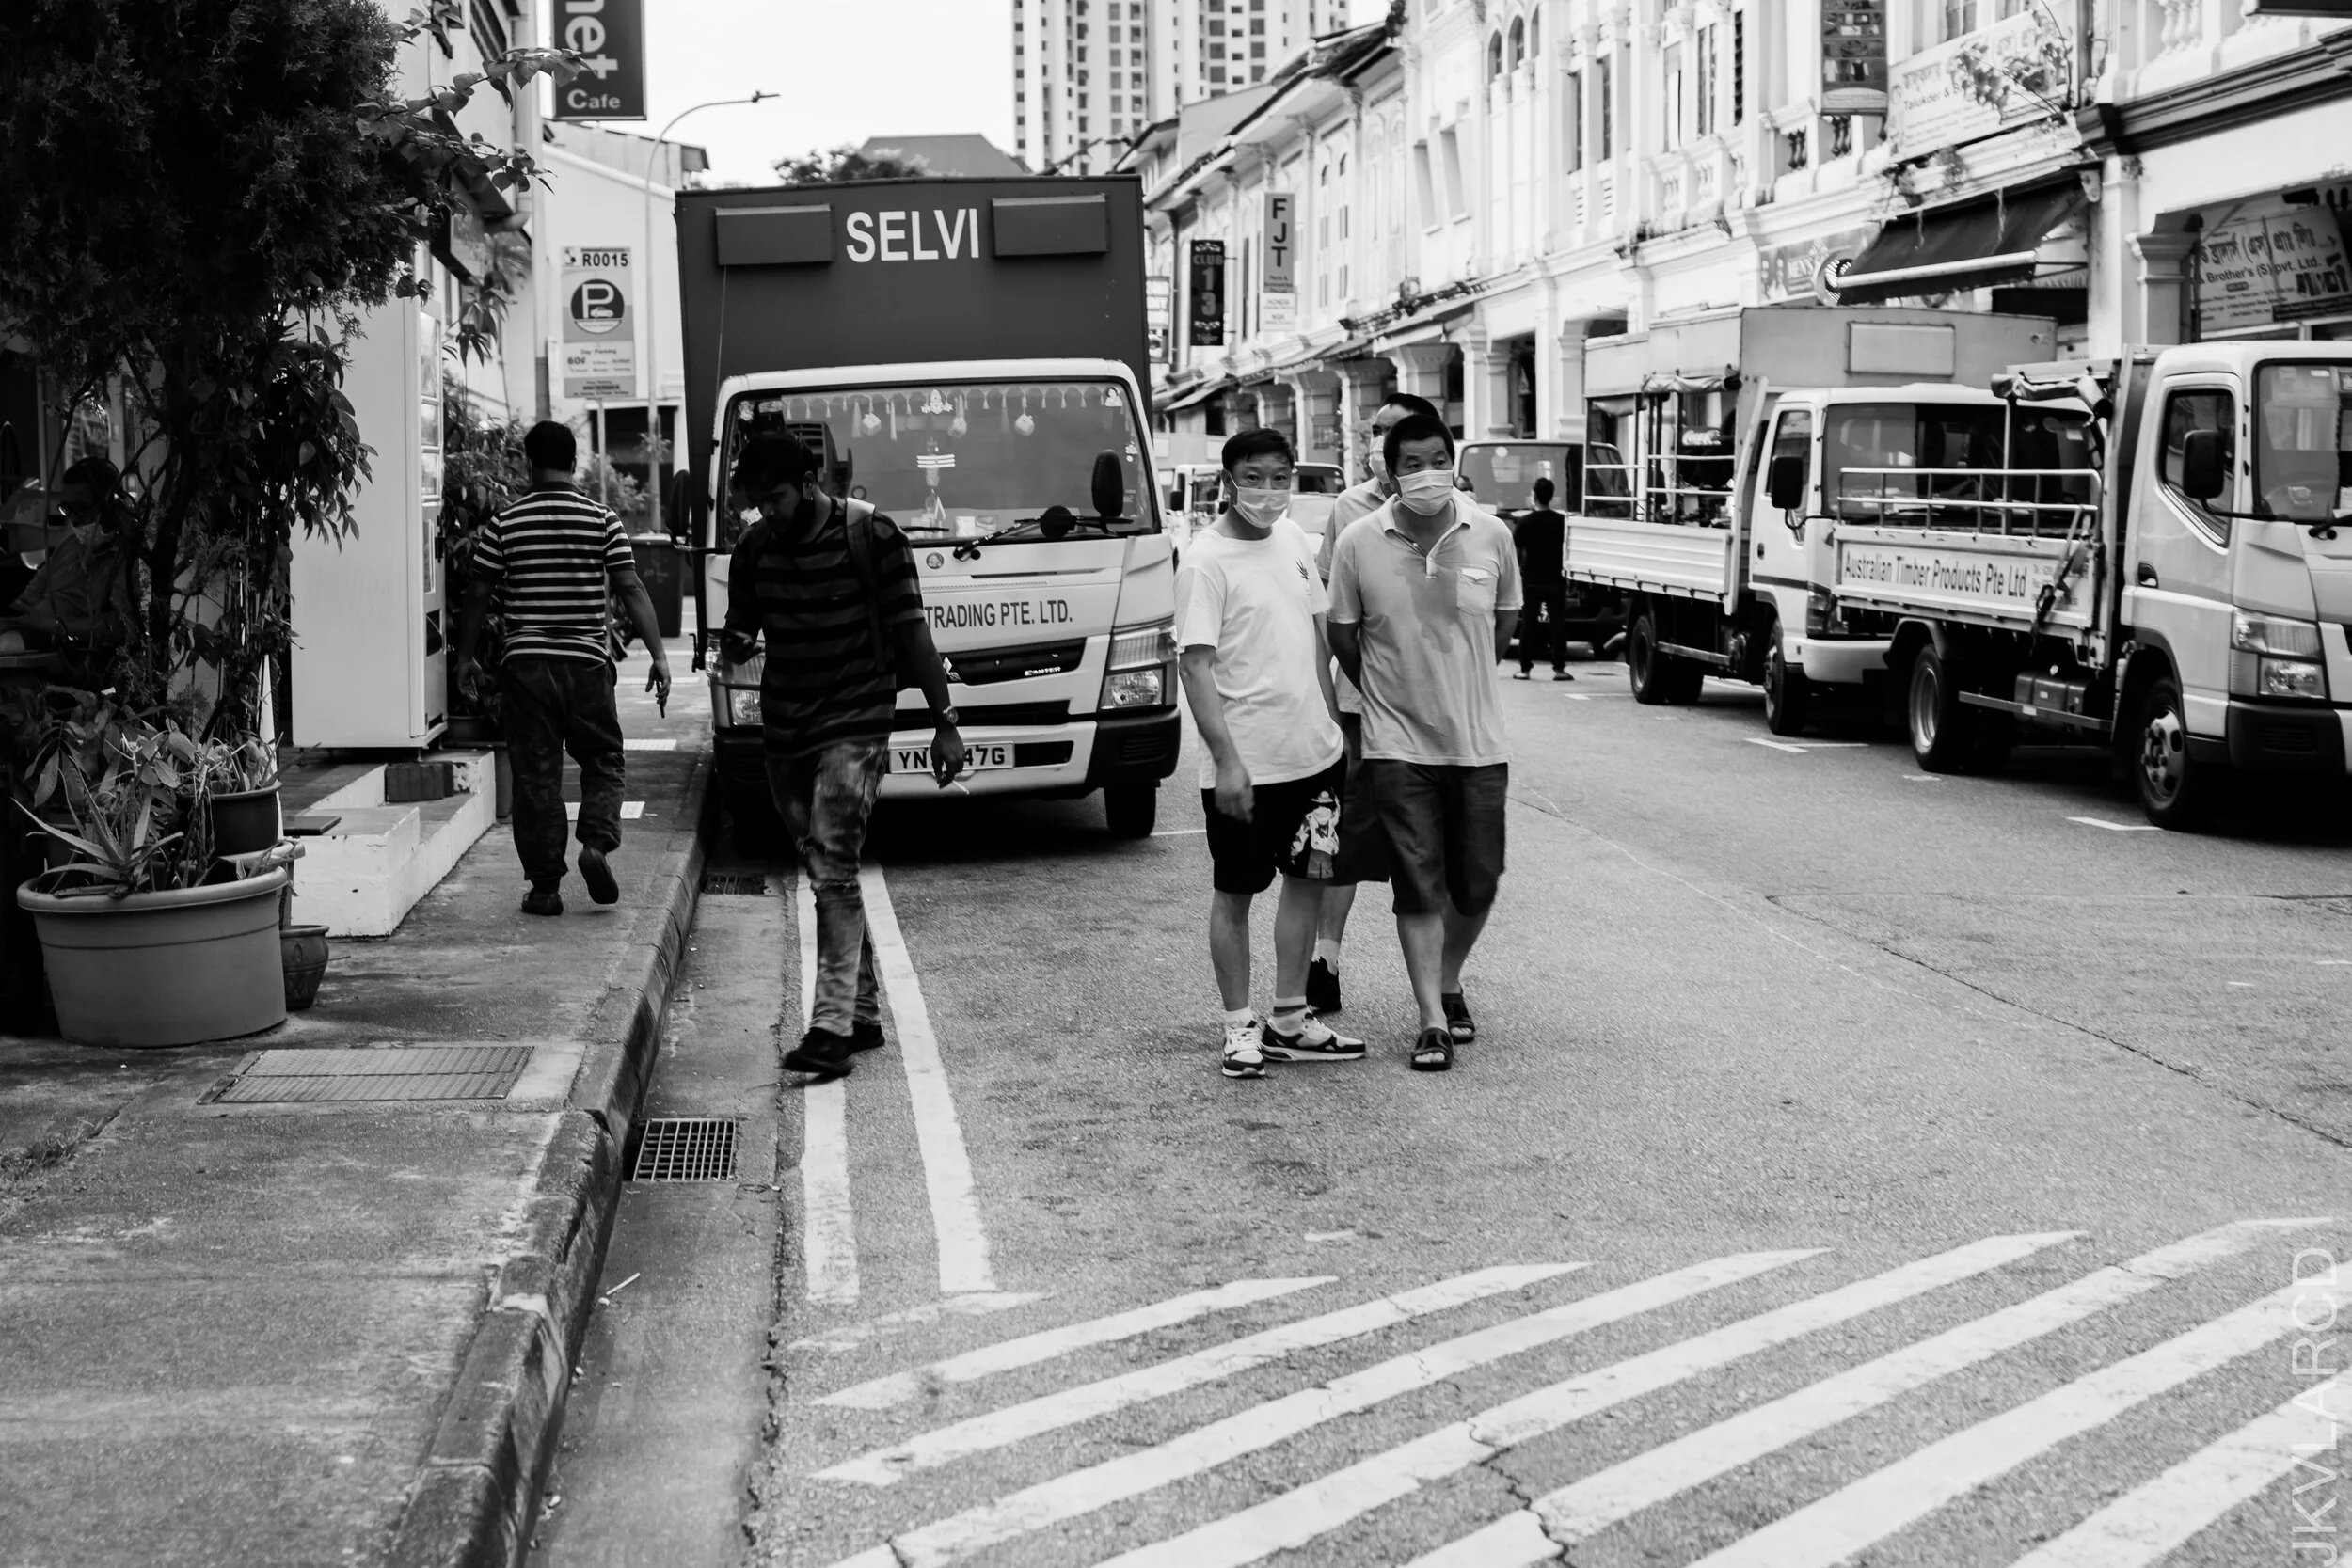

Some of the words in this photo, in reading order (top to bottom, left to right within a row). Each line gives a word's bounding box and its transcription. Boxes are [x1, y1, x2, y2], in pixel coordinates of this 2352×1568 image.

[567, 88, 621, 109] Cafe
[846, 208, 979, 262] SELVI
[1271, 198, 1288, 268] FJT
[582, 253, 628, 267] R0015
[1193, 254, 1223, 265] CLUB
[2206, 267, 2254, 283] Brother's
[2257, 263, 2272, 277] (S)
[2297, 256, 2322, 269] Ltd.
[582, 282, 614, 319] P
[1844, 550, 1892, 582] Australian
[1896, 556, 1930, 587] Timber
[1931, 559, 1980, 592] Products
[1985, 562, 2003, 594] Pte
[2009, 565, 2026, 597] Ltd
[924, 603, 995, 628] TRADING
[1001, 601, 1034, 626] PTE.
[1040, 599, 1073, 624] LTD.
[899, 746, 1005, 769] YN47G
